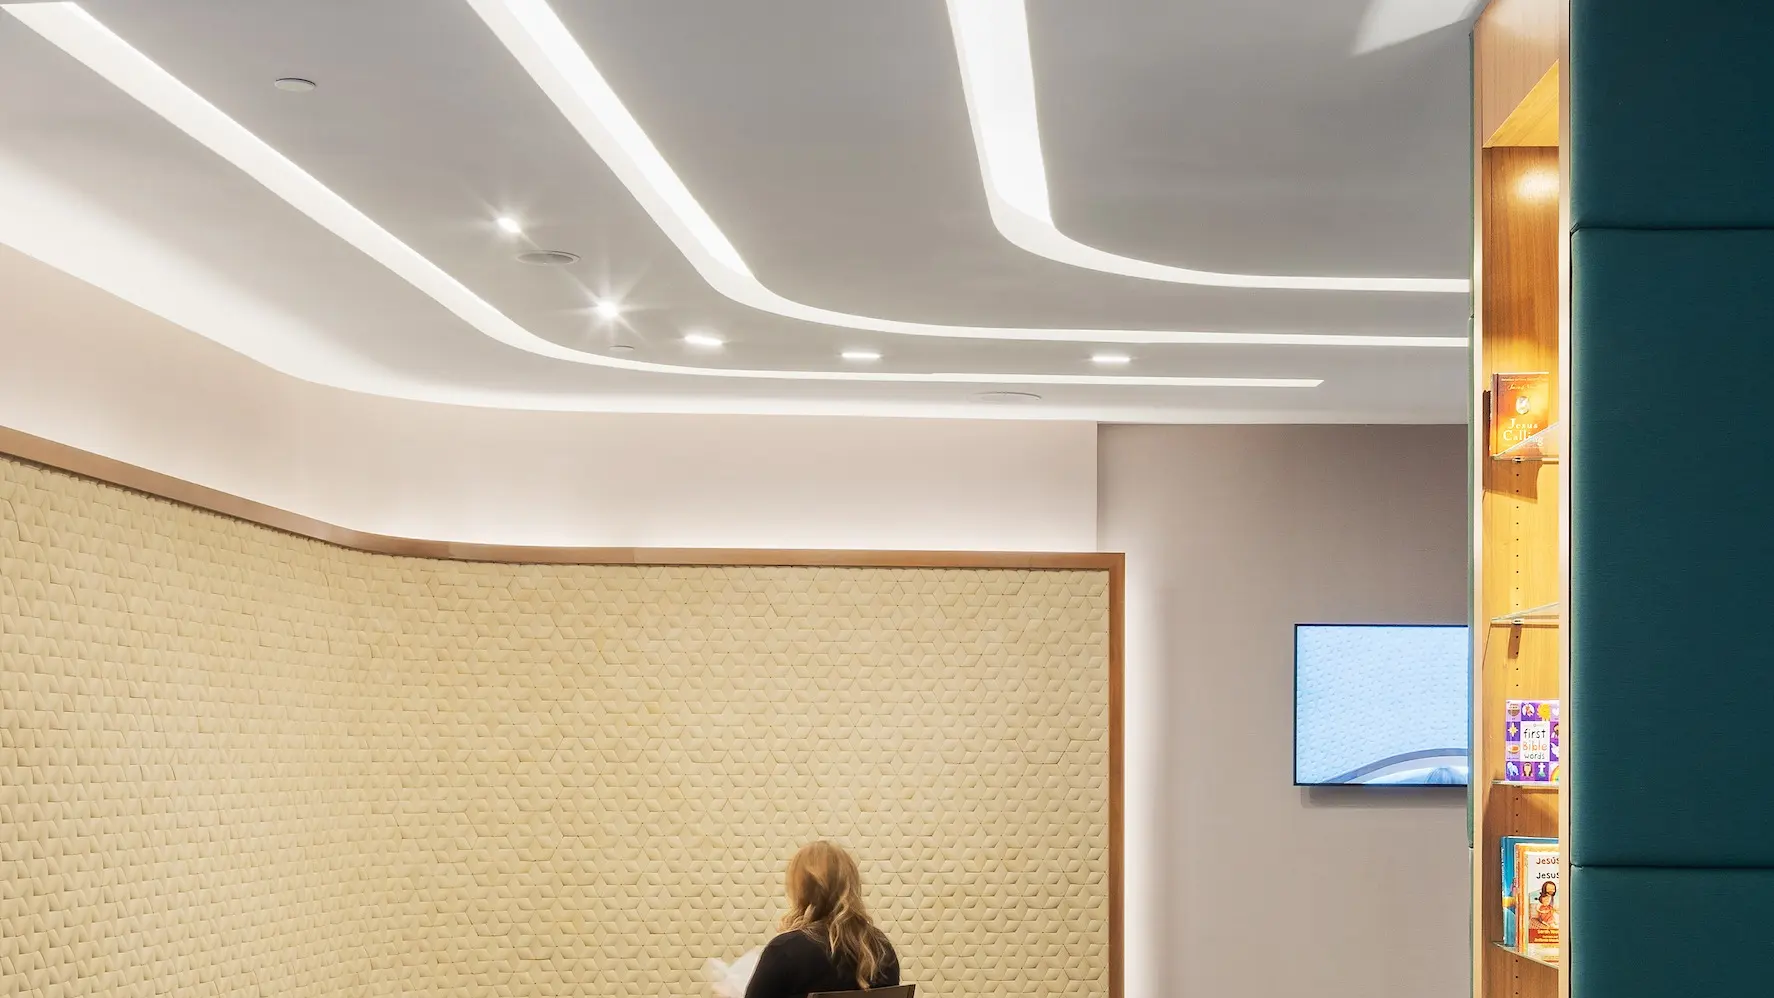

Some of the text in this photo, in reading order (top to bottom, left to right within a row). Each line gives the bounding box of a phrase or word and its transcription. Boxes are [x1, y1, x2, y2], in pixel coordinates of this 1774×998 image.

[1509, 418, 1538, 429] Jesus
[1523, 728, 1546, 739] first
[1522, 742, 1547, 751] Bible
[1523, 752, 1545, 760] words
[1536, 872, 1559, 880] Jesus
